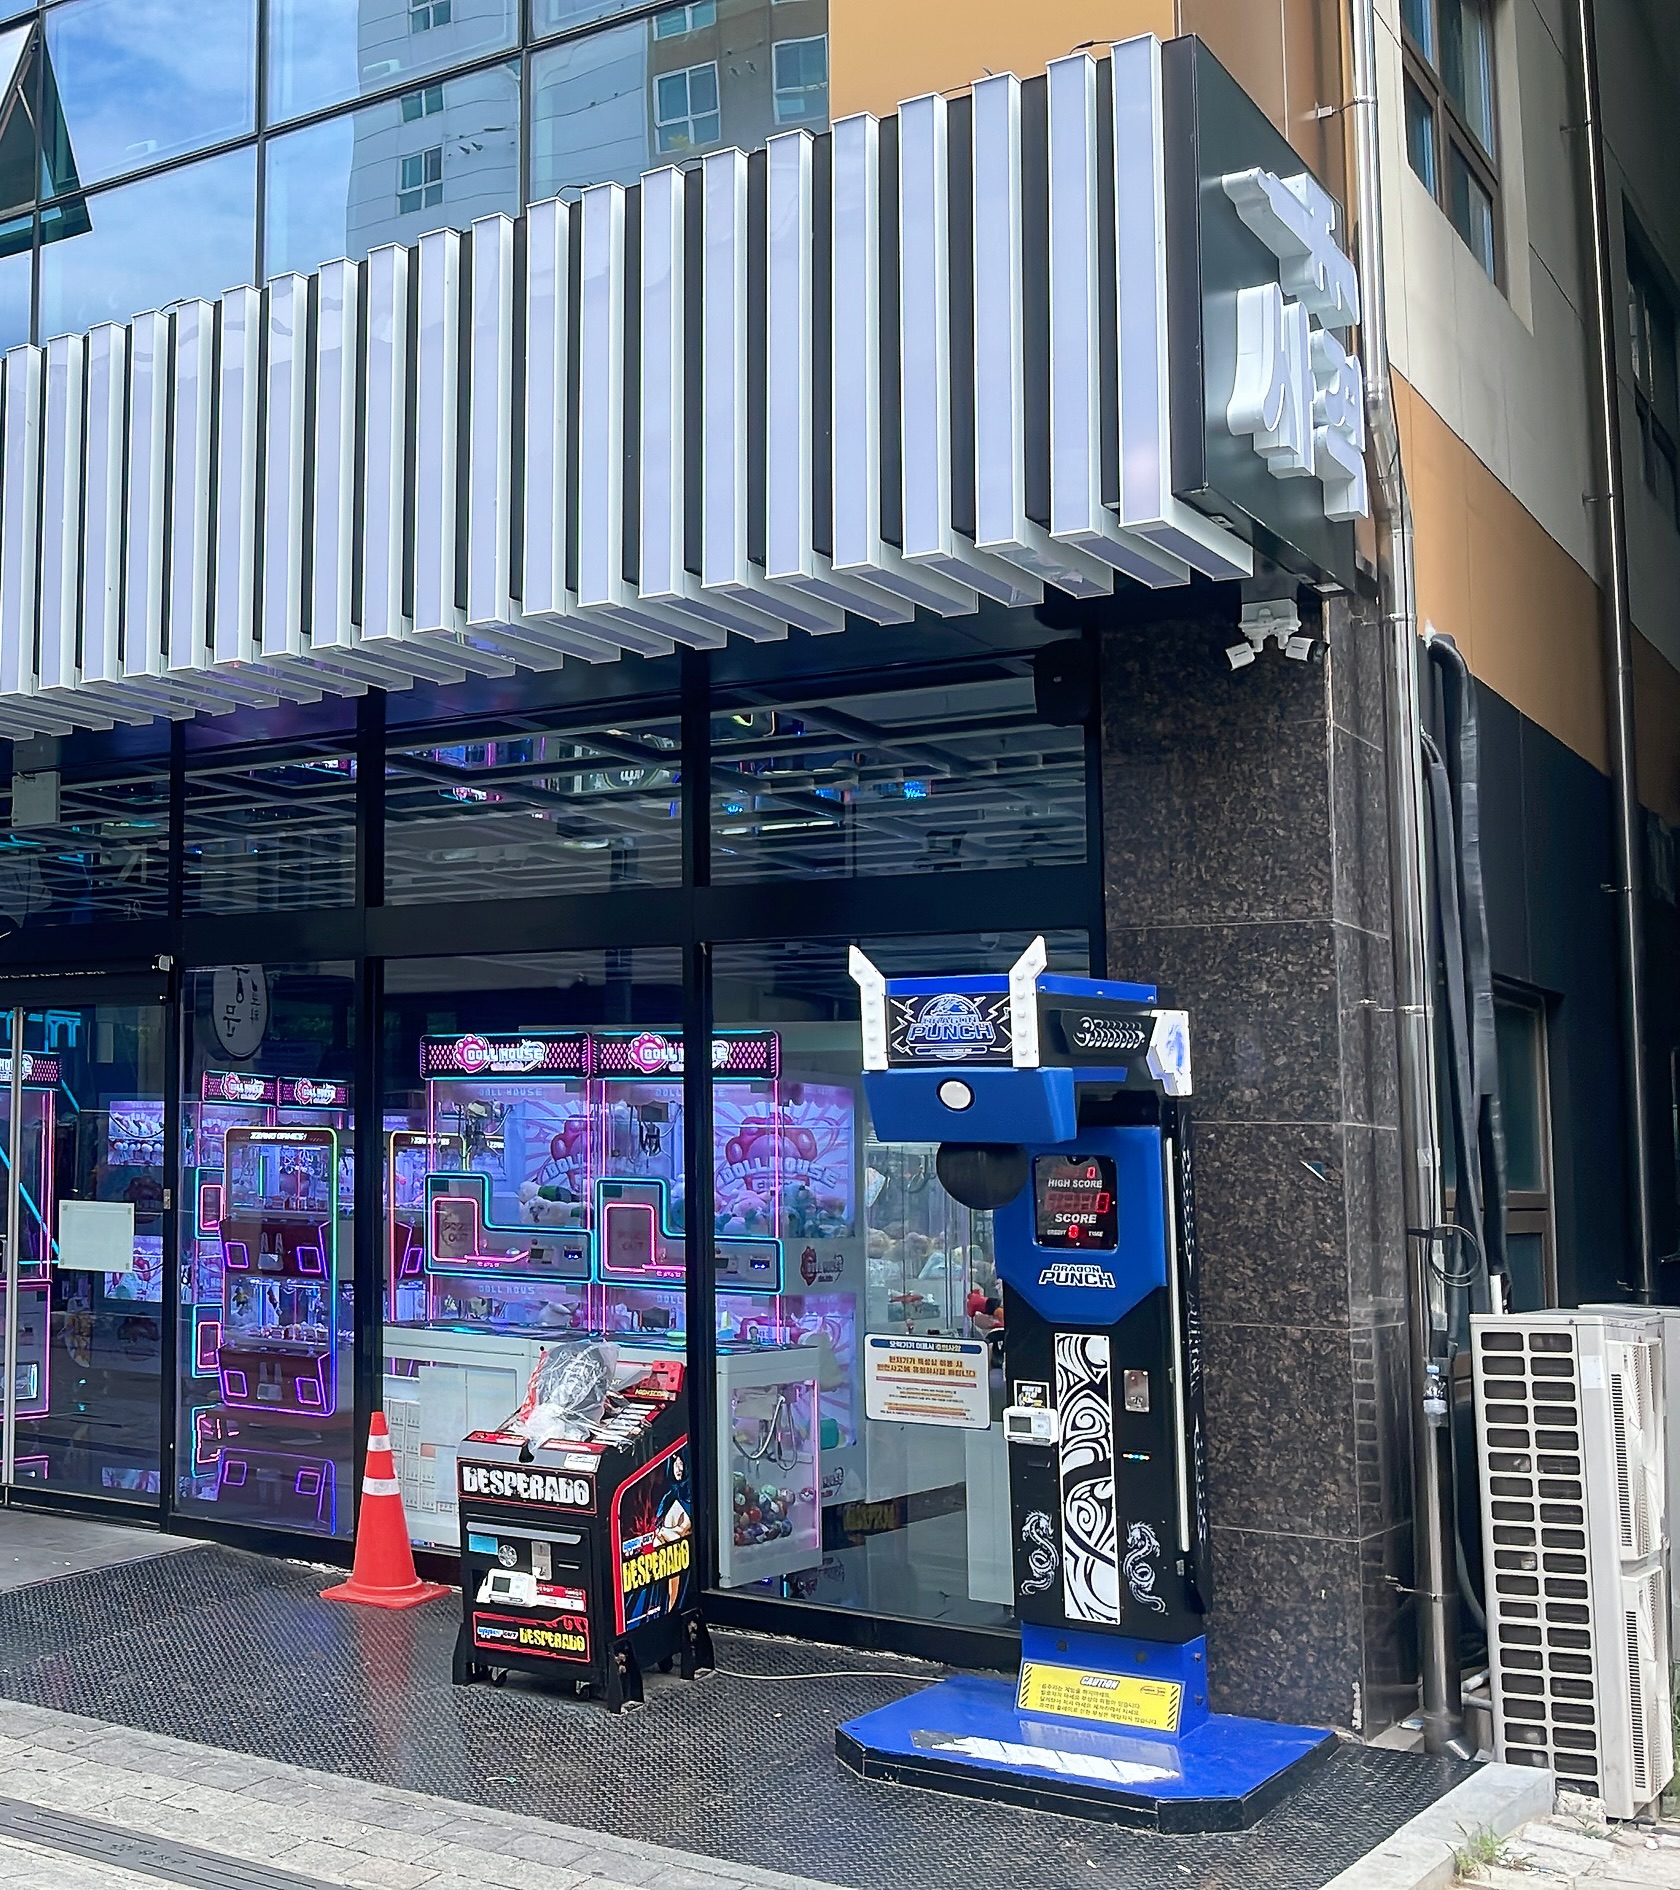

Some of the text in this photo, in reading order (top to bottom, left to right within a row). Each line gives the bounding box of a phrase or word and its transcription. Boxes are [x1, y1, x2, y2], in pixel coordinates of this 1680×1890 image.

[907, 1021, 995, 1041] PUNCH
[467, 1046, 545, 1062] DOLL HOUSE
[644, 1048, 678, 1061] DOLL
[721, 1157, 768, 1184] DOLL
[1048, 1179, 1103, 1189] HIGH SCORE
[1055, 1213, 1097, 1224] SCORE
[1052, 1264, 1101, 1274] DRAGON
[1039, 1270, 1116, 1288] PUNCH
[462, 1466, 590, 1506] DESPERADO
[623, 1539, 690, 1592] DESPERADO
[519, 1627, 586, 1652] DESPERADO
[1080, 1675, 1120, 1690] CAUTION
